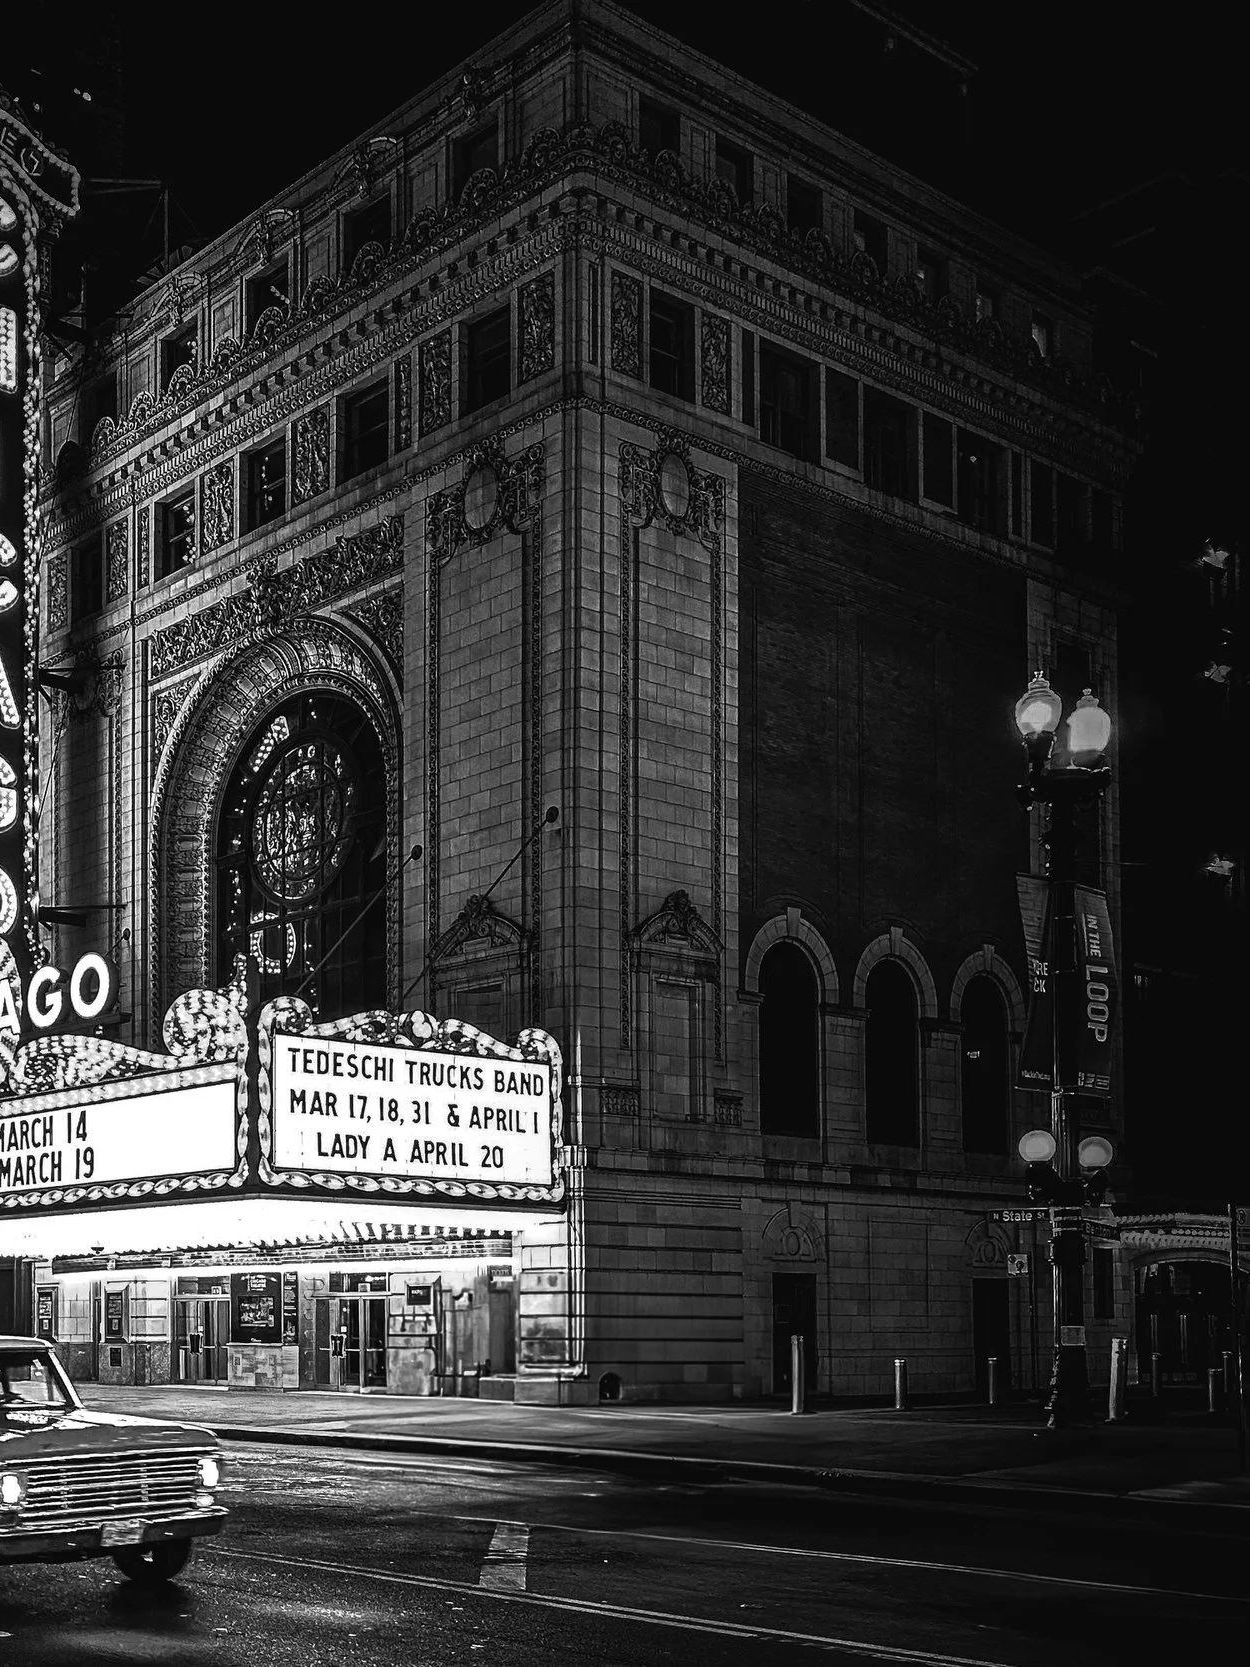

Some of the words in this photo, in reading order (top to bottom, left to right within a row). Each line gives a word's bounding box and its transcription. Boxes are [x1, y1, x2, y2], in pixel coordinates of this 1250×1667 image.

[1089, 932, 1102, 957] THE
[1085, 964, 1109, 1043] LOOP
[287, 1047, 394, 1082] TEDESCHI
[404, 1060, 484, 1091] TRUCKS
[494, 1069, 544, 1097] BAND
[67, 1111, 88, 1144] 14
[290, 1088, 338, 1117] MAR
[411, 1100, 430, 1125] 31
[447, 1103, 460, 1128] &
[468, 1105, 527, 1134] APRIL
[75, 1146, 95, 1180] 19
[316, 1132, 371, 1160] LADY
[383, 1137, 398, 1162] A
[409, 1139, 469, 1167] APRIL
[480, 1144, 504, 1169] 20
[993, 1212, 999, 1220] N
[1002, 1210, 1033, 1221] State
[1037, 1211, 1045, 1219] St
